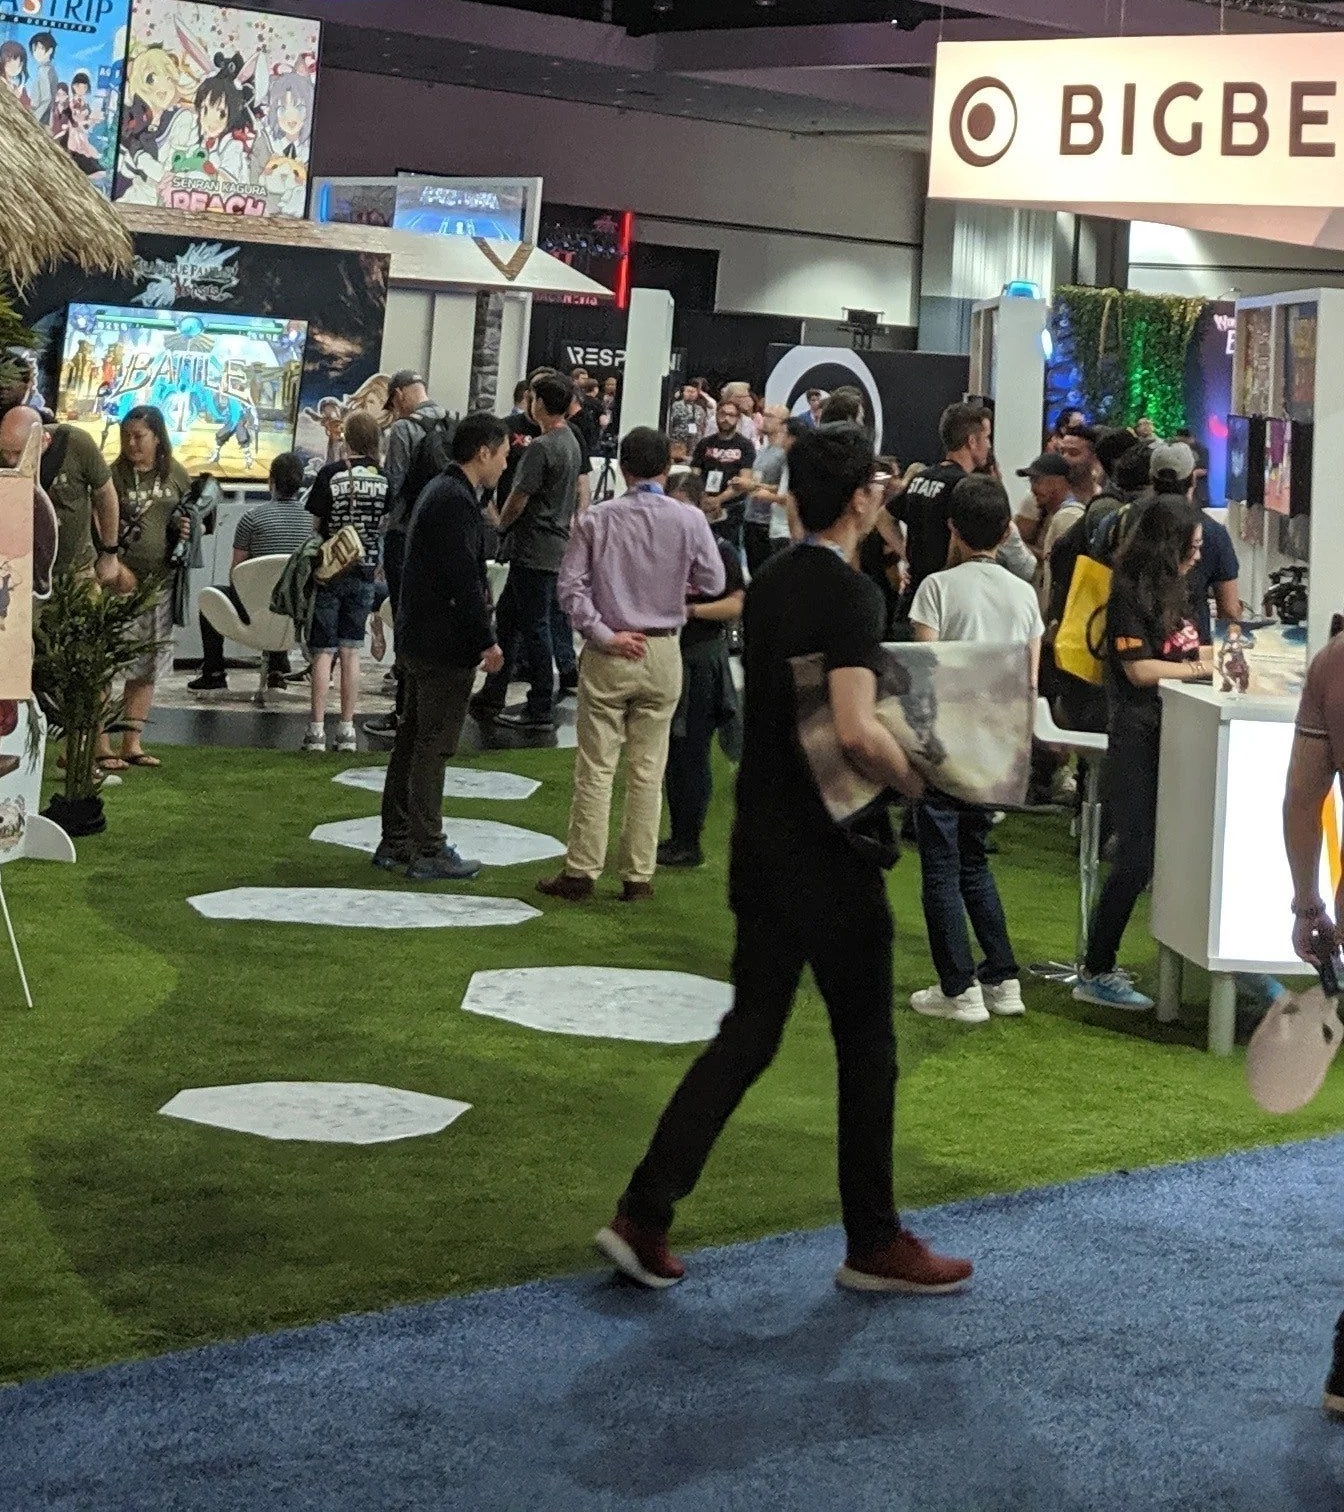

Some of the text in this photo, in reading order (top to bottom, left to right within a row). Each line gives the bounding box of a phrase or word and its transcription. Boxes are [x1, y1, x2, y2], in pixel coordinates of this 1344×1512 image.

[171, 176, 267, 197] SENRAN KAGURA
[907, 476, 946, 499] STAFF
